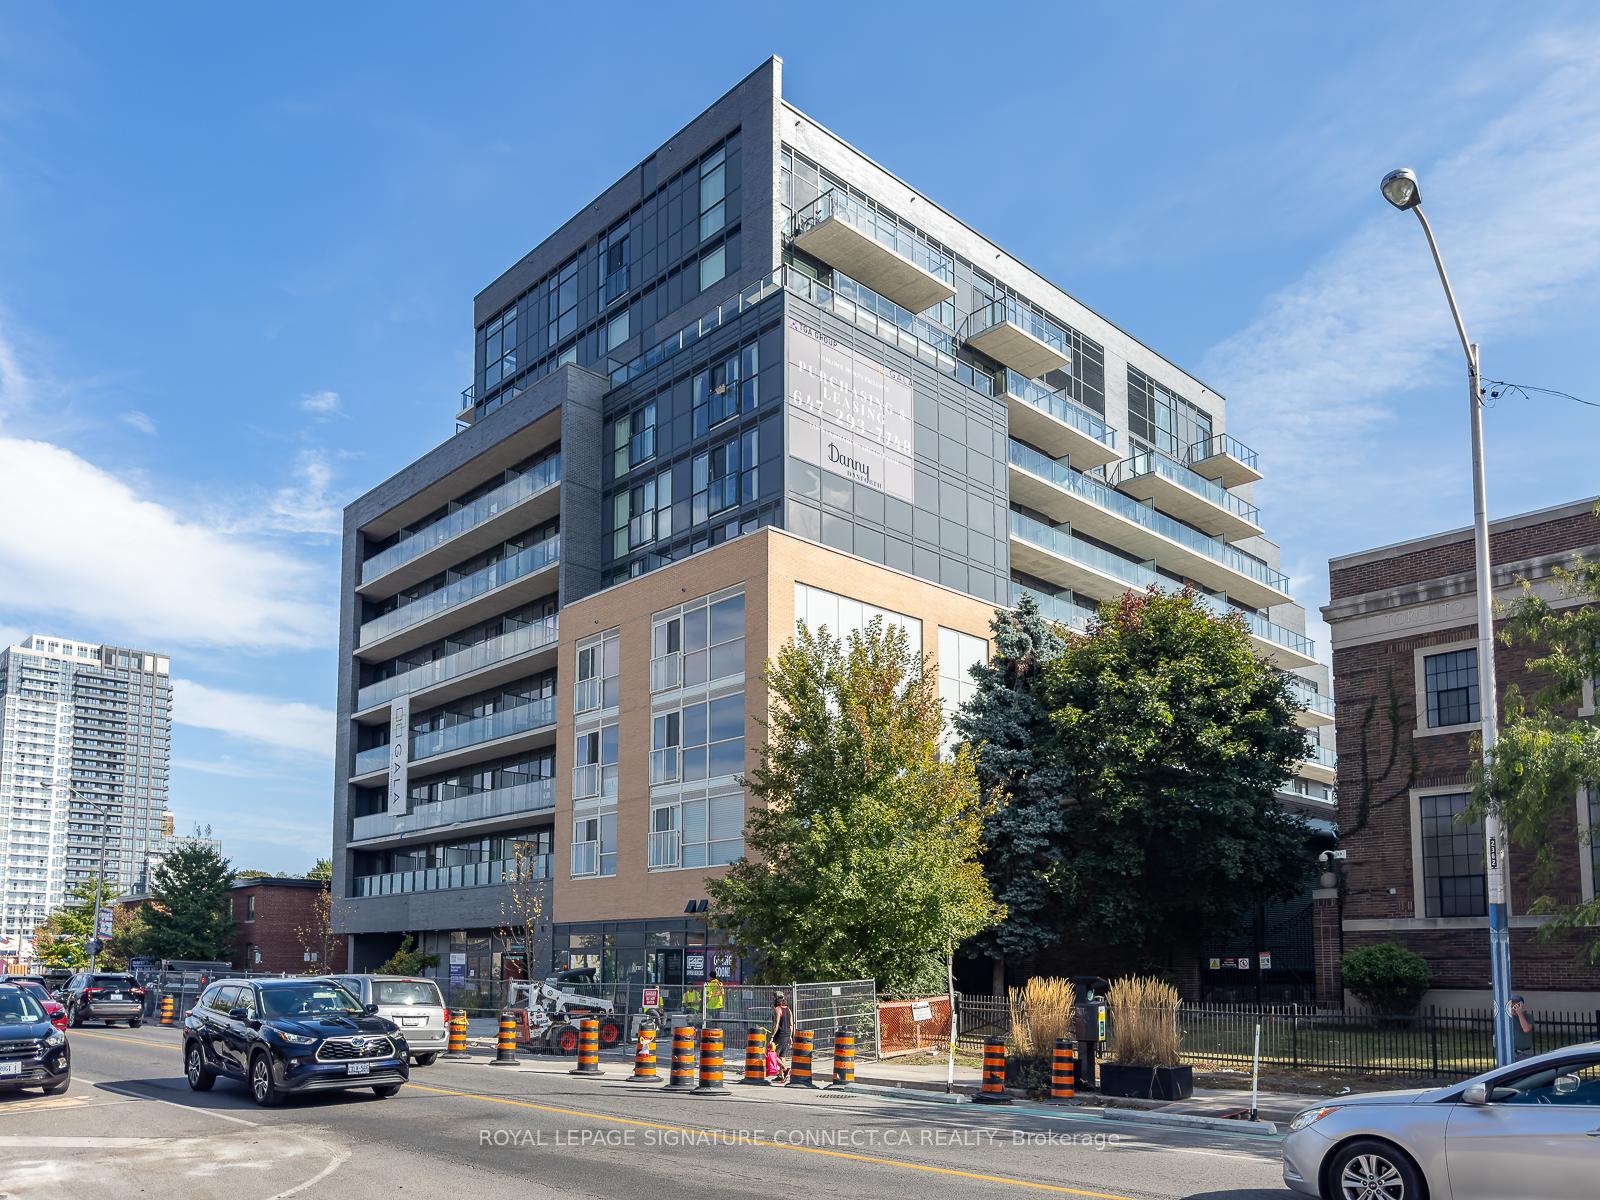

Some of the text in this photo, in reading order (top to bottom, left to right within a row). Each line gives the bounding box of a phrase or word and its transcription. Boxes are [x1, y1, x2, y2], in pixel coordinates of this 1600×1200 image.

[798, 360, 894, 415] PURCHASING
[823, 386, 885, 425] LEASING
[828, 442, 869, 483] Danny
